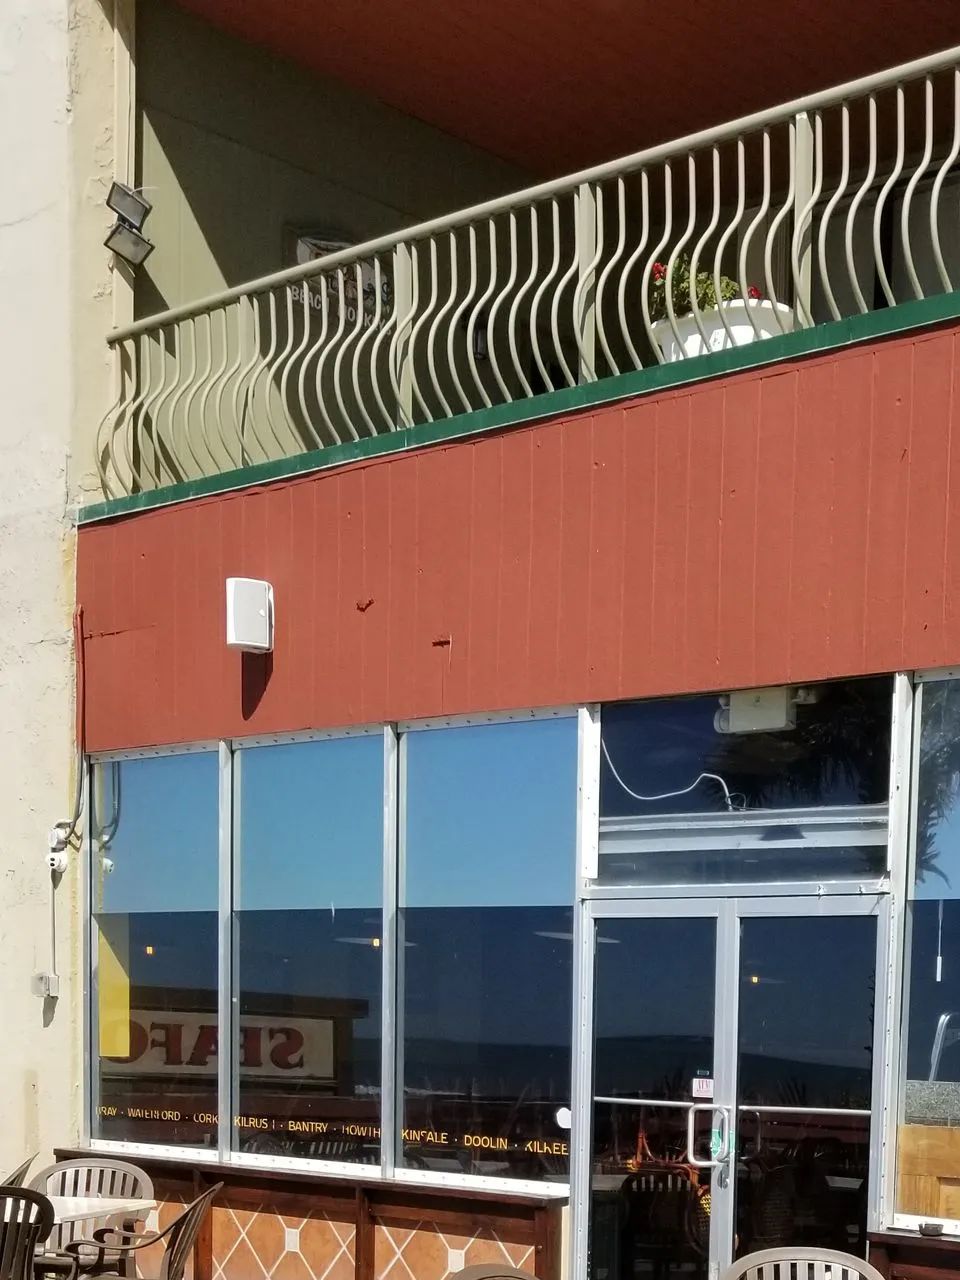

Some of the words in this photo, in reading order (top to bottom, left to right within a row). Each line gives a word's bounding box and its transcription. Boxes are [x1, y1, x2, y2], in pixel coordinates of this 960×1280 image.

[193, 1113, 219, 1124] CORK
[288, 1120, 329, 1133] BANTRY
[464, 1134, 508, 1150] DOOLIN
